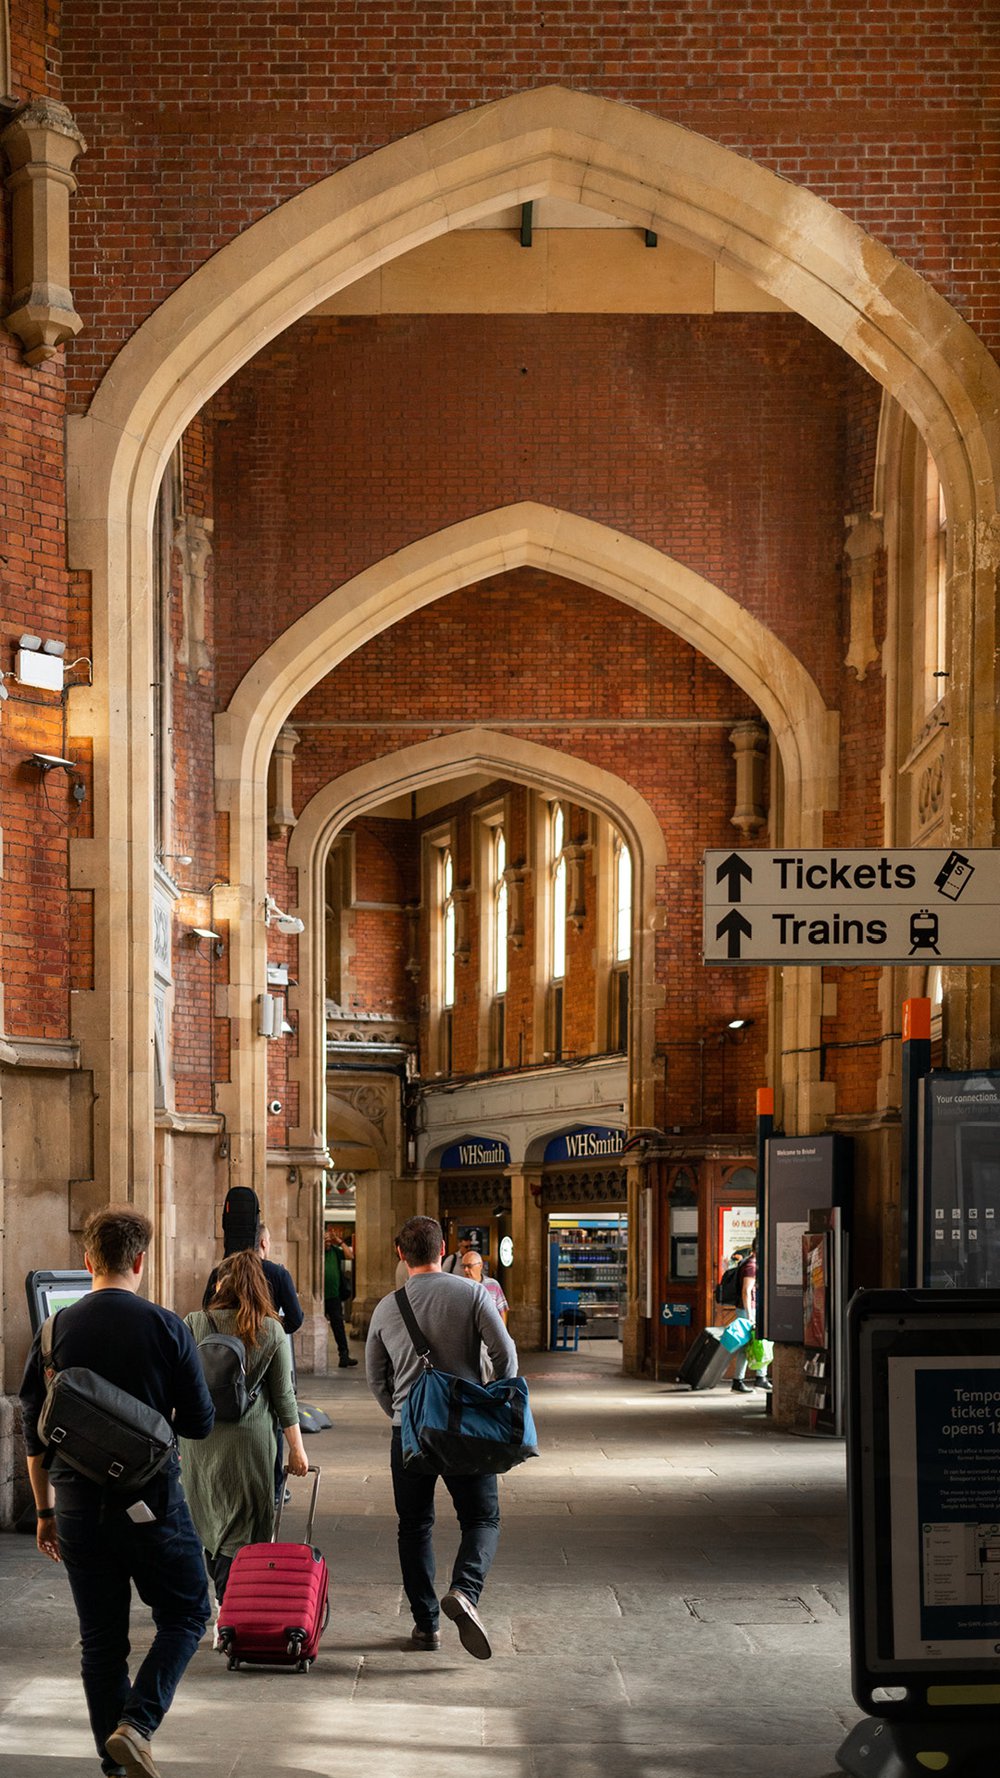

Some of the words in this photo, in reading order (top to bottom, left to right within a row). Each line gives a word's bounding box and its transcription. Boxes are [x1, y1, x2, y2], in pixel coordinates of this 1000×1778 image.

[772, 857, 917, 890] Tickets
[771, 913, 888, 945] Trains
[936, 1094, 953, 1104] Your
[954, 1092, 998, 1103] connections
[565, 1130, 624, 1158] WHSmith
[776, 1148, 796, 1156] Welcome
[801, 1147, 816, 1155] Bristol
[458, 1142, 505, 1165] WHSmith
[951, 1405, 992, 1418] ticket
[942, 1424, 984, 1438] opens
